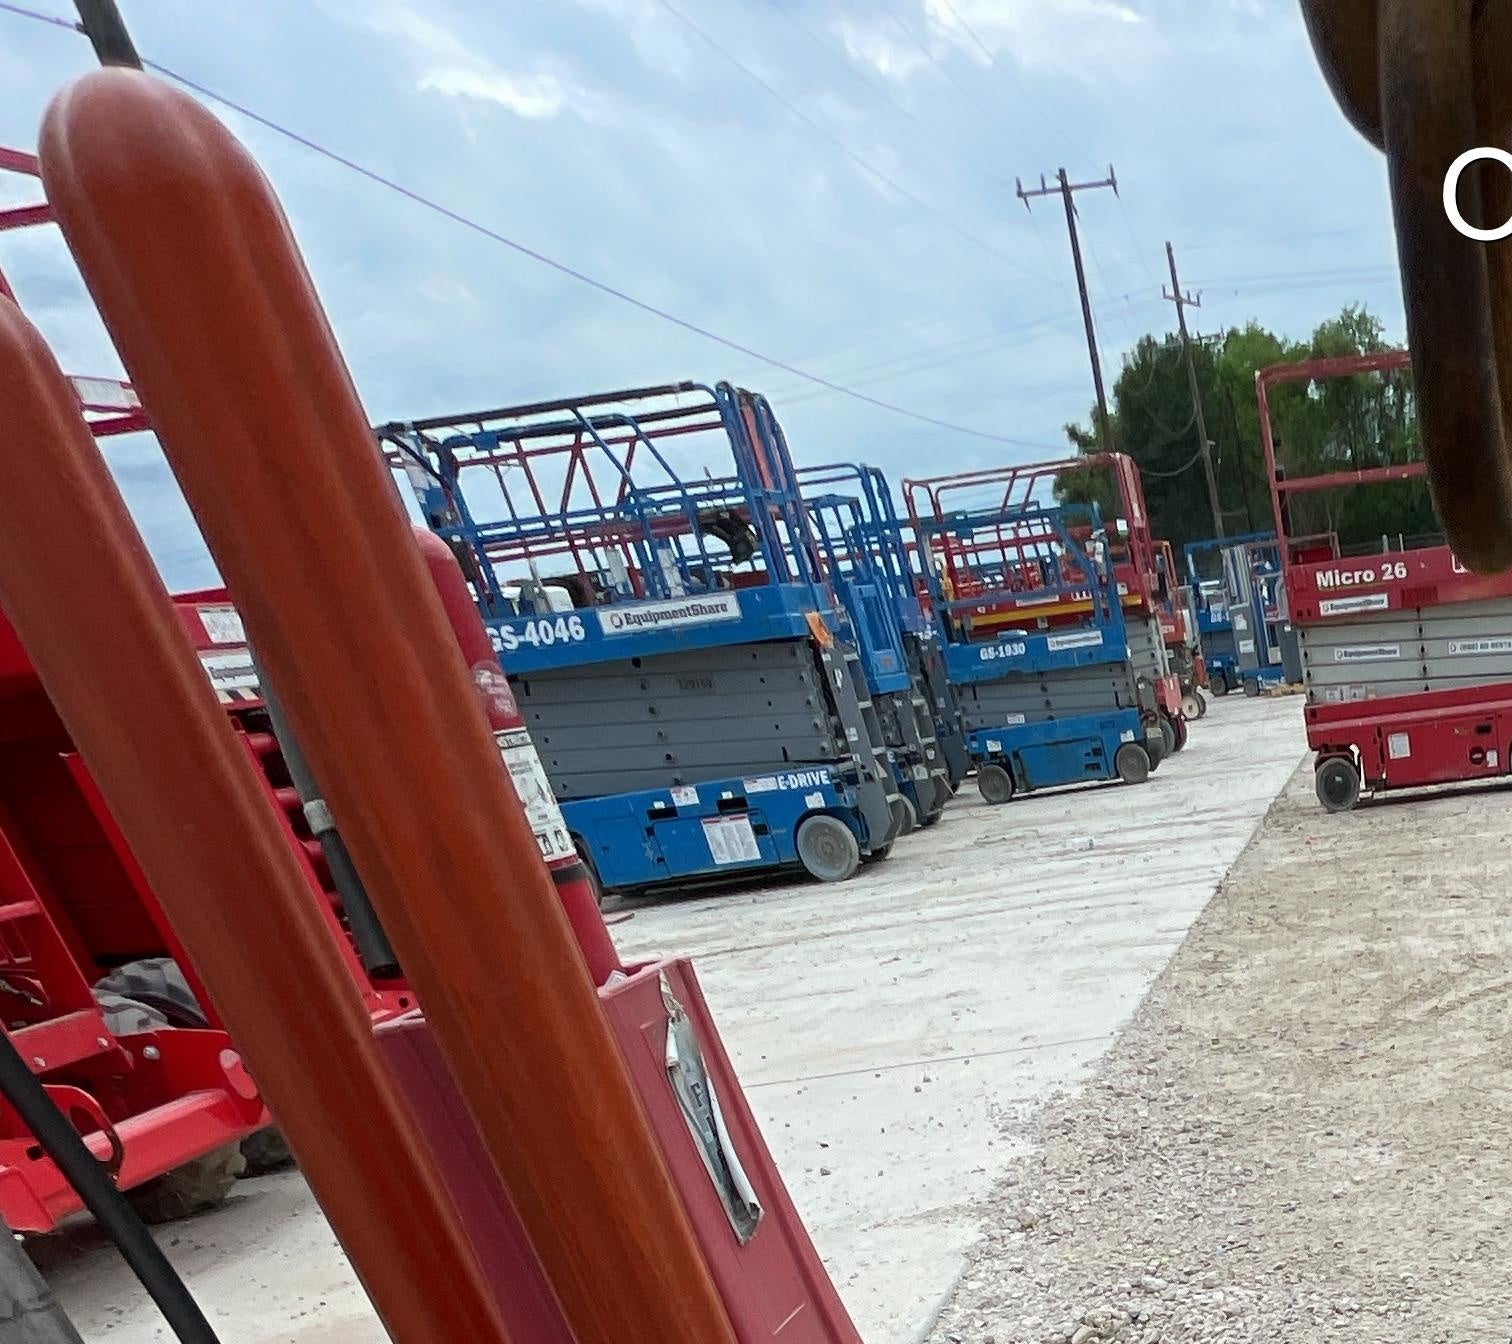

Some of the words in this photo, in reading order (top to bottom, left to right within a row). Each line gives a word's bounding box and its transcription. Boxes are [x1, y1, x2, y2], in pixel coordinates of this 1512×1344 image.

[1316, 569, 1375, 587] Micro
[1381, 562, 1407, 580] 26
[625, 601, 729, 627] EquipmentShare
[487, 614, 586, 652] GS-4046
[980, 642, 1026, 661] GS-1930
[778, 770, 830, 790] E-DRIVE
